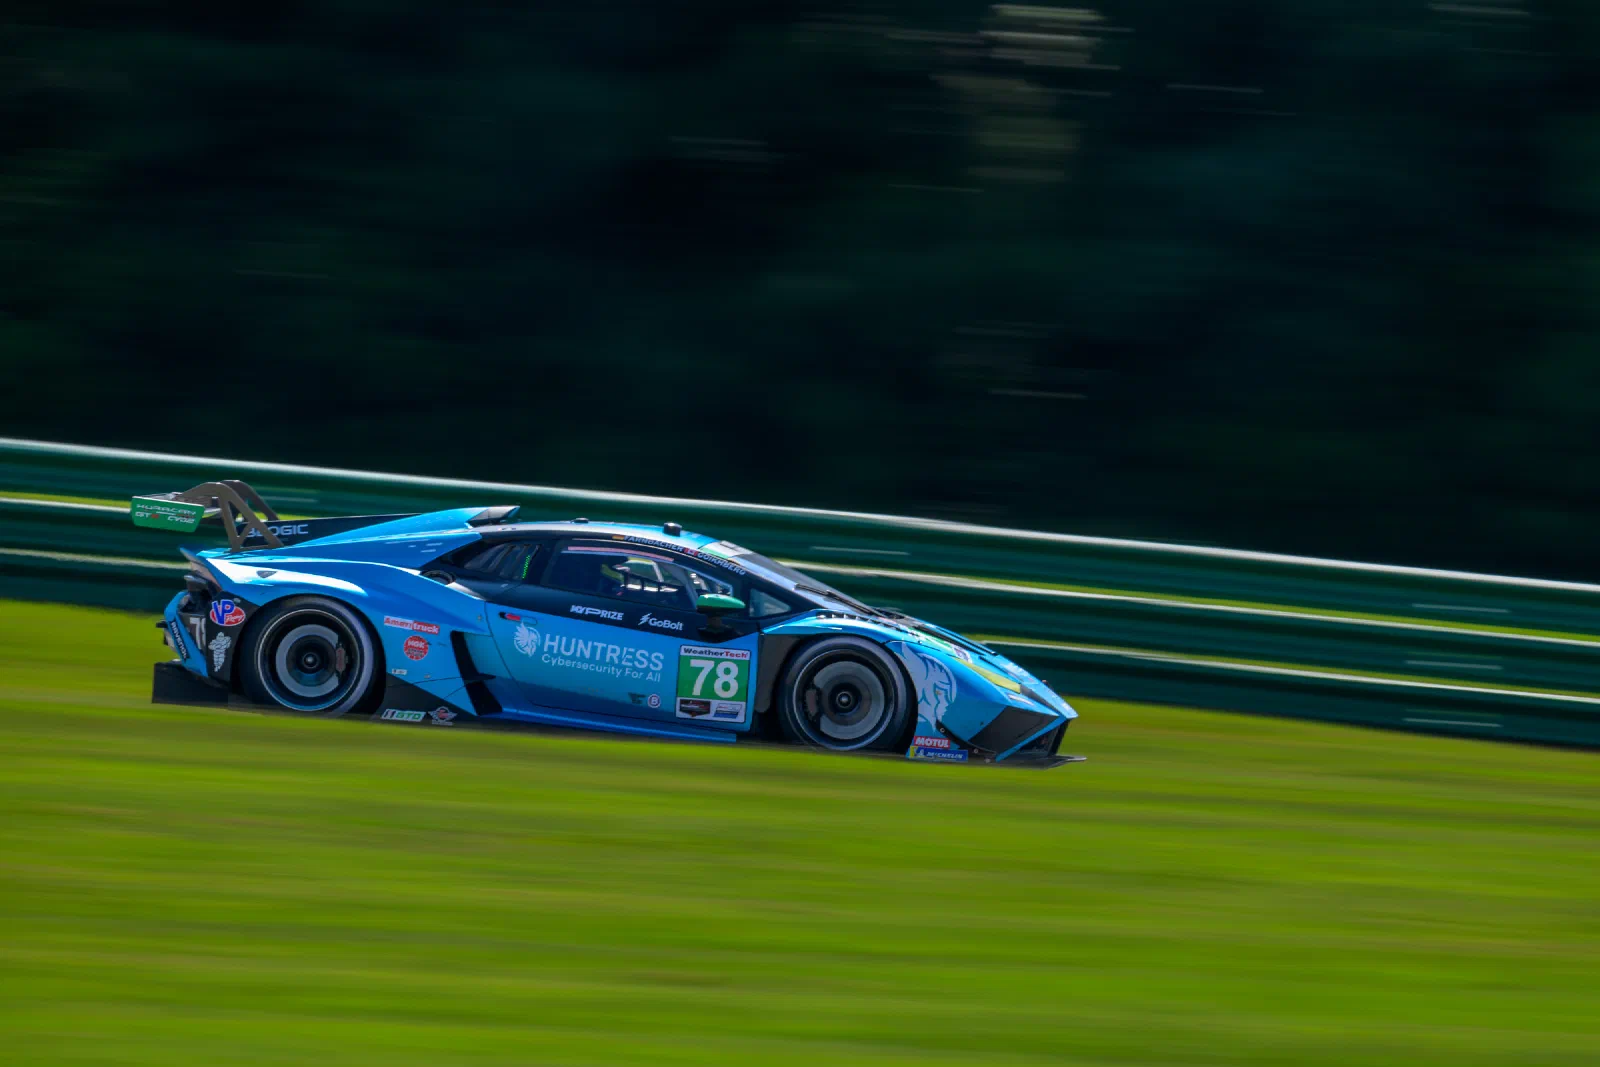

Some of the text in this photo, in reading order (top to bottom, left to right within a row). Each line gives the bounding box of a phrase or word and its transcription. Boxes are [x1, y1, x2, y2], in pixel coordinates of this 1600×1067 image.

[648, 617, 684, 631] GoBolt
[543, 633, 665, 672] HUNTRESS
[683, 647, 748, 659] WeatherTech
[541, 653, 661, 682] Cybersecurity For All
[689, 659, 739, 699] 78
[915, 737, 949, 748] MOTUL
